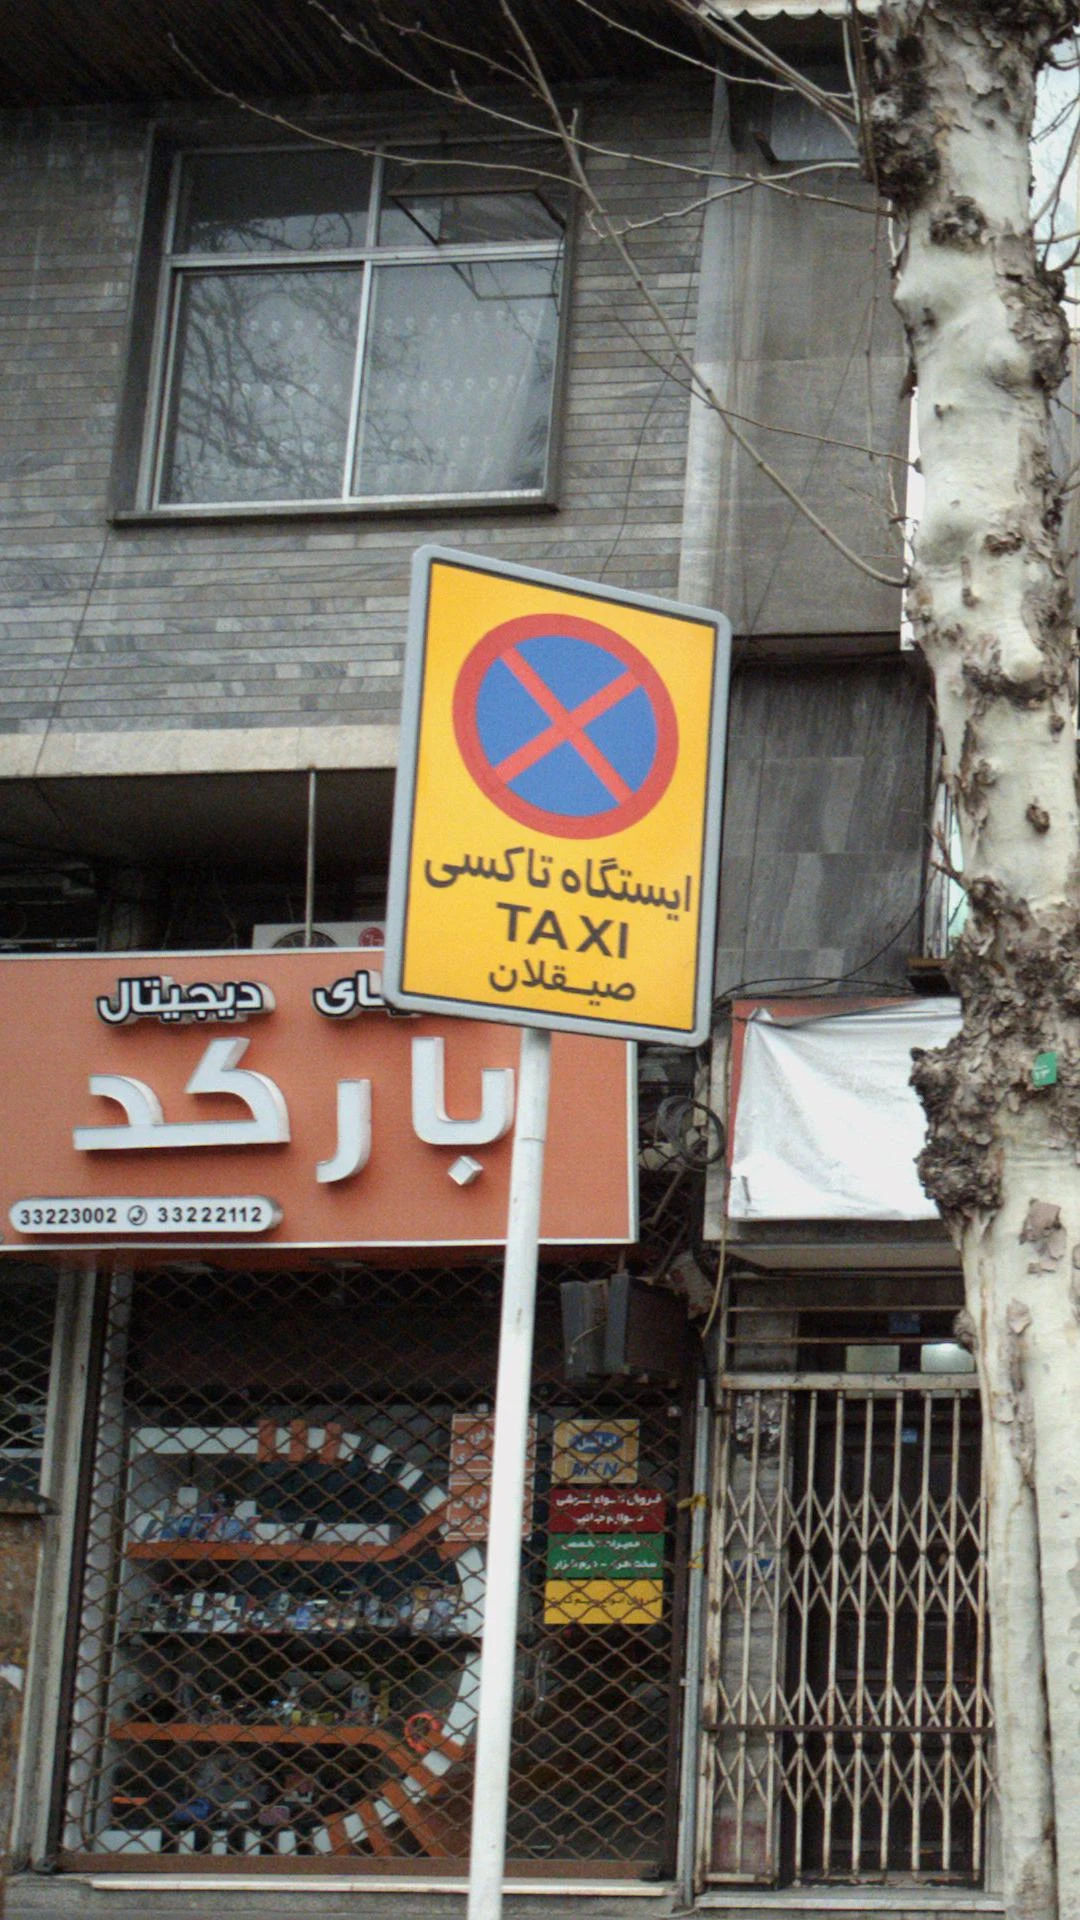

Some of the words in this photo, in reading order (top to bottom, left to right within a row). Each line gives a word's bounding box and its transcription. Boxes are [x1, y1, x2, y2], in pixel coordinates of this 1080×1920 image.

[424, 846, 553, 889] تاکسی
[561, 857, 693, 922] ایستگاه
[496, 901, 630, 960] TAXI
[97, 974, 268, 1026] دیجیتال
[20, 1207, 117, 1226] 33223002
[158, 1206, 262, 1224] 33222112
